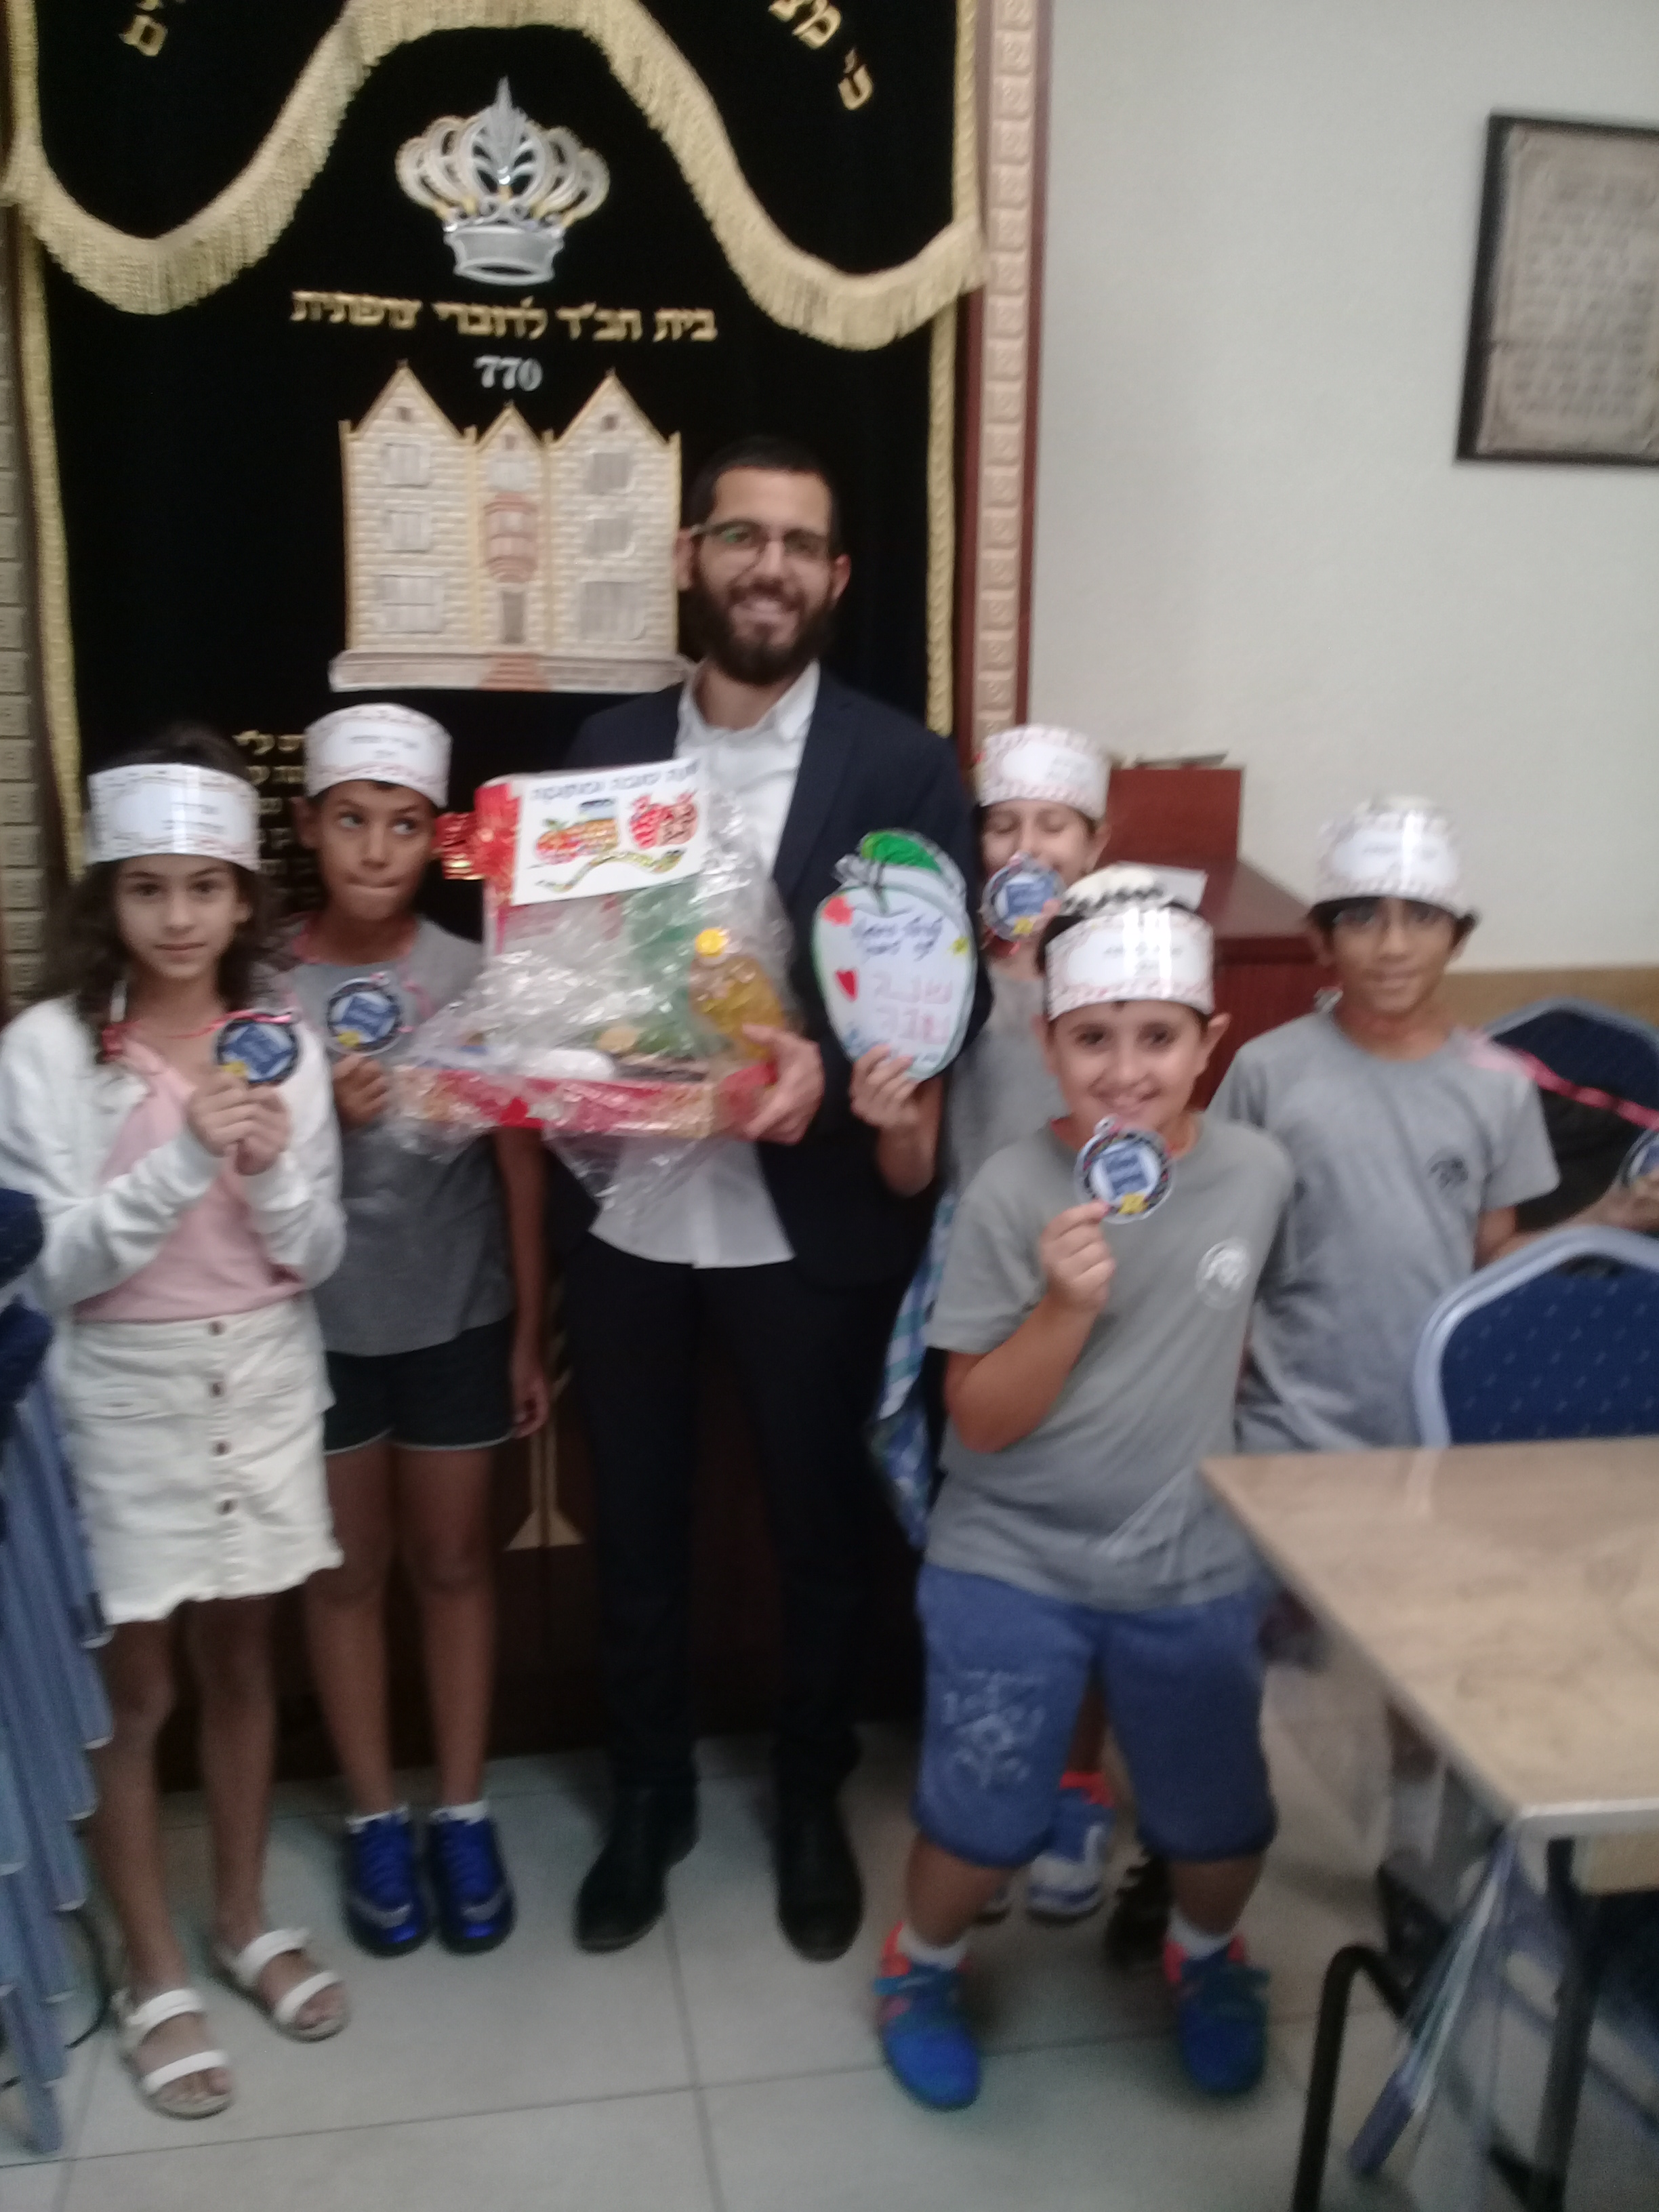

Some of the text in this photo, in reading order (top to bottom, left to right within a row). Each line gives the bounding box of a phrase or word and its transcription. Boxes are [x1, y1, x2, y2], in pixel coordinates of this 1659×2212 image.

[432, 296, 548, 339] לדוברי
[654, 308, 718, 342] בית
[475, 356, 542, 390] 770
